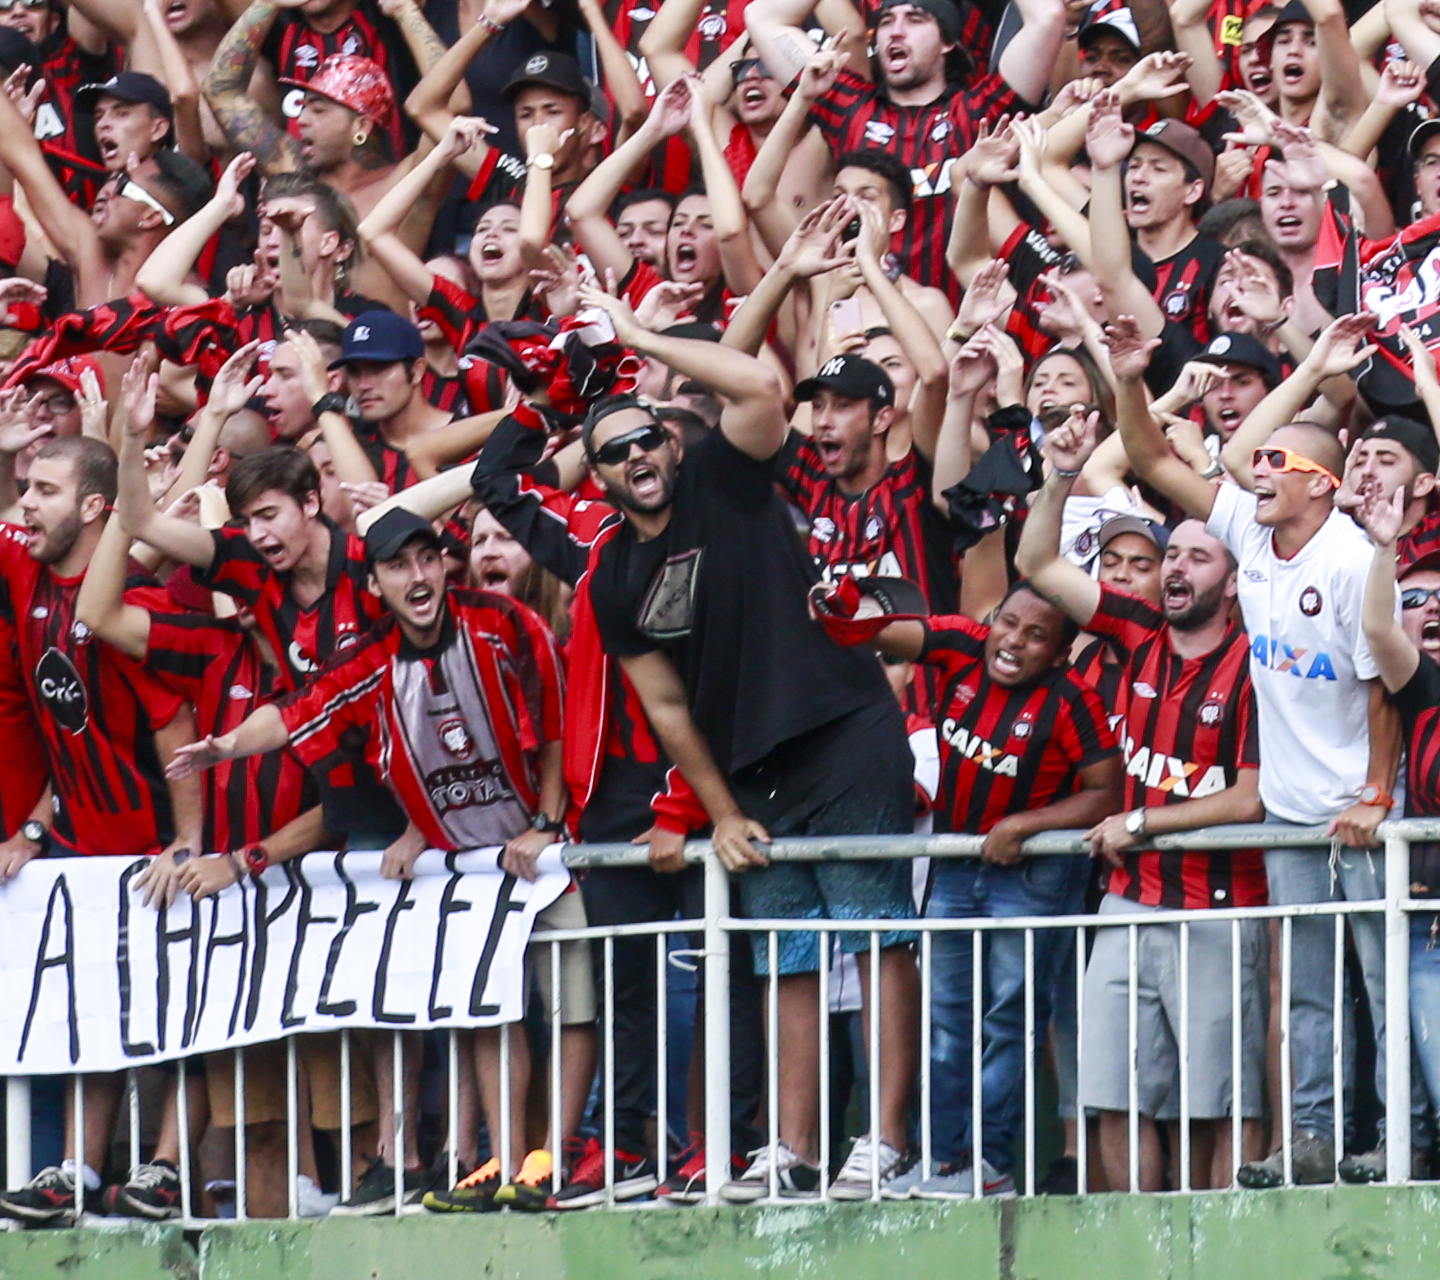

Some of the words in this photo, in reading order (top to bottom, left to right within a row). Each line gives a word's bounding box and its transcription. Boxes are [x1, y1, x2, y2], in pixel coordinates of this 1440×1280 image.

[1249, 631, 1338, 682] AIXA
[941, 717, 1020, 778] CAIXA
[16, 874, 81, 1065] A
